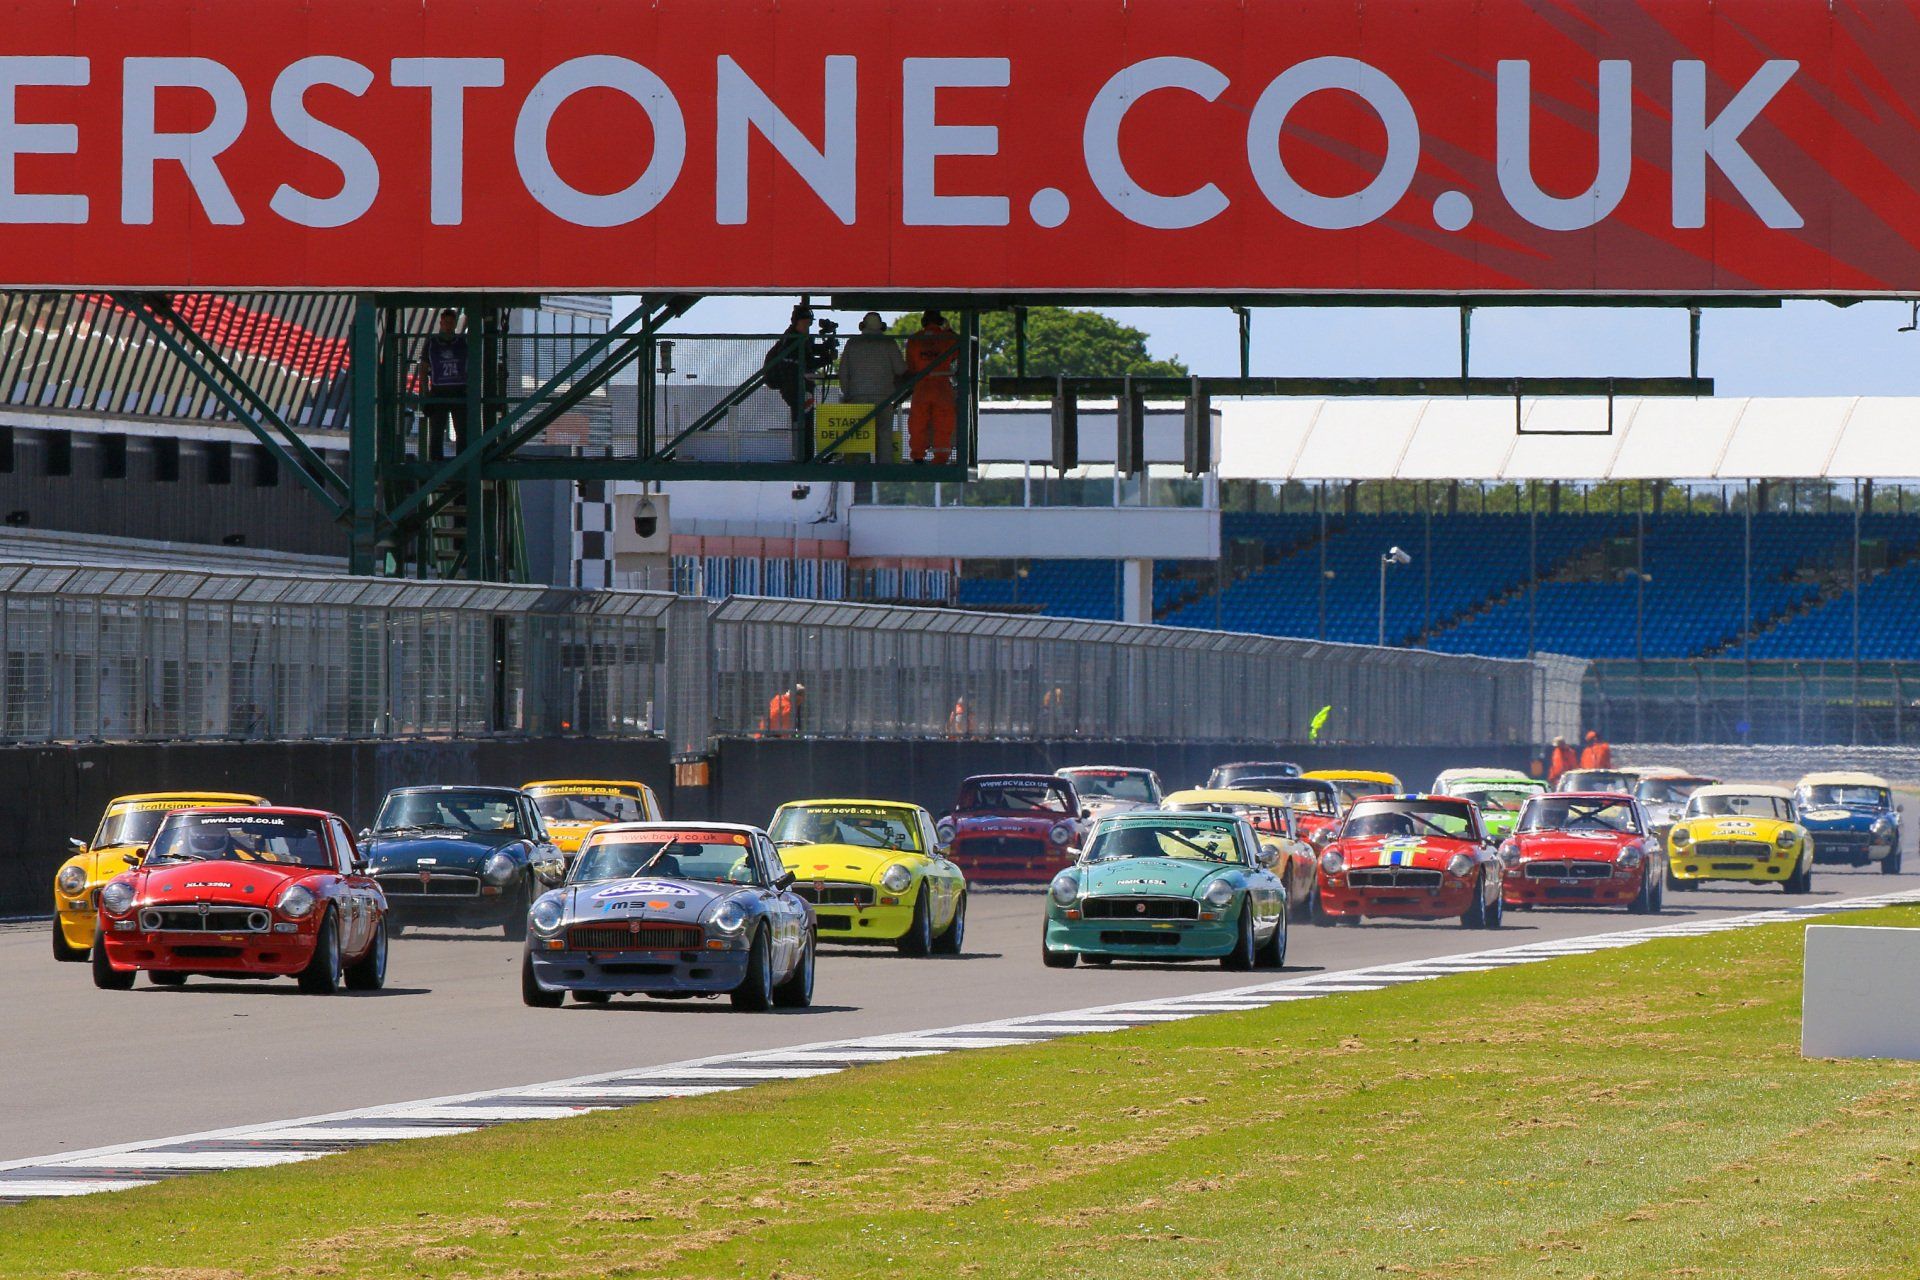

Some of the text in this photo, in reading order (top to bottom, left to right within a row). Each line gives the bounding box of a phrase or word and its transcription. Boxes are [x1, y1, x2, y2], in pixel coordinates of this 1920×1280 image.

[0, 54, 1804, 231] ERSTONE.CO.UK
[442, 363, 458, 376] 274
[821, 430, 870, 440] DELYED
[806, 807, 887, 815] www.bcv8.couk
[201, 816, 285, 826] www.bcv8.co.uk
